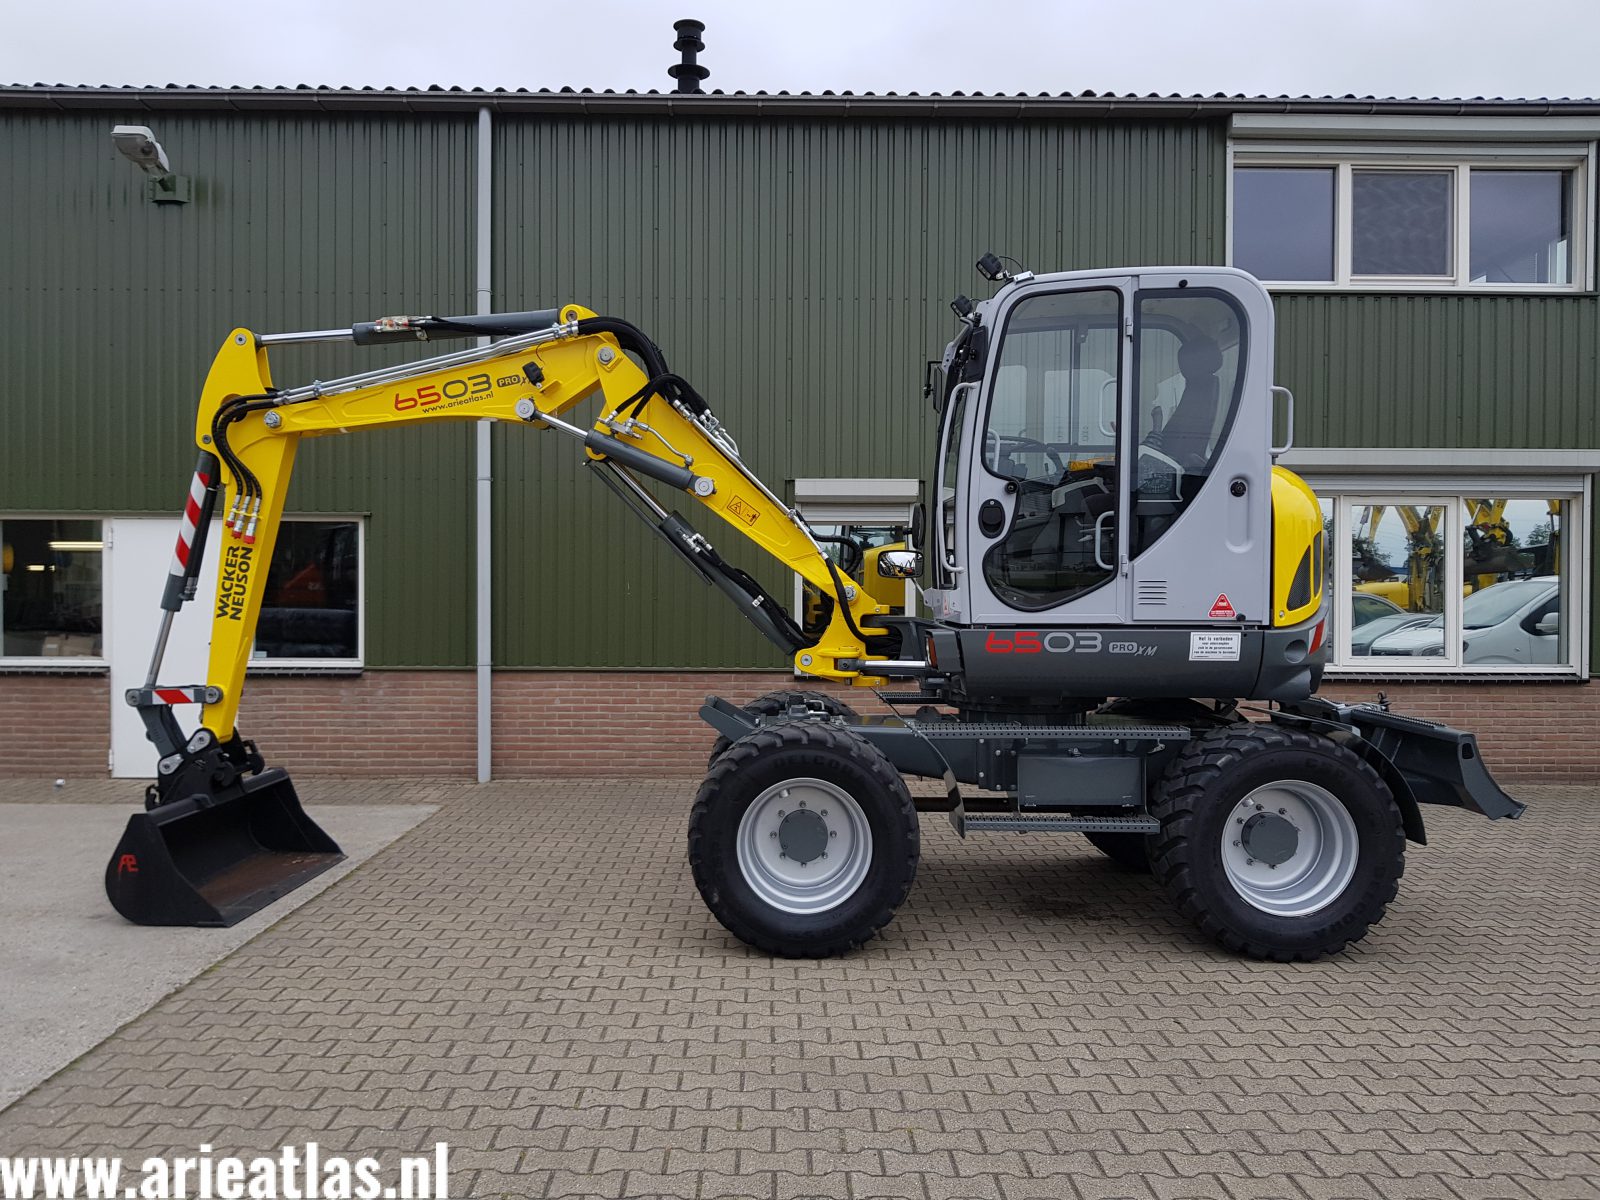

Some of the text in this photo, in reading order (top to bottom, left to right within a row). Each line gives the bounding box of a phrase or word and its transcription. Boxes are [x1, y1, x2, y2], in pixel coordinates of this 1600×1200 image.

[394, 373, 493, 412] 6503
[498, 375, 520, 387] PRO
[422, 391, 494, 414] www.arieatlas.nl
[216, 545, 240, 619] WACKER
[229, 546, 253, 621] NEUSON
[985, 631, 1158, 657] 6503 PRO XM
